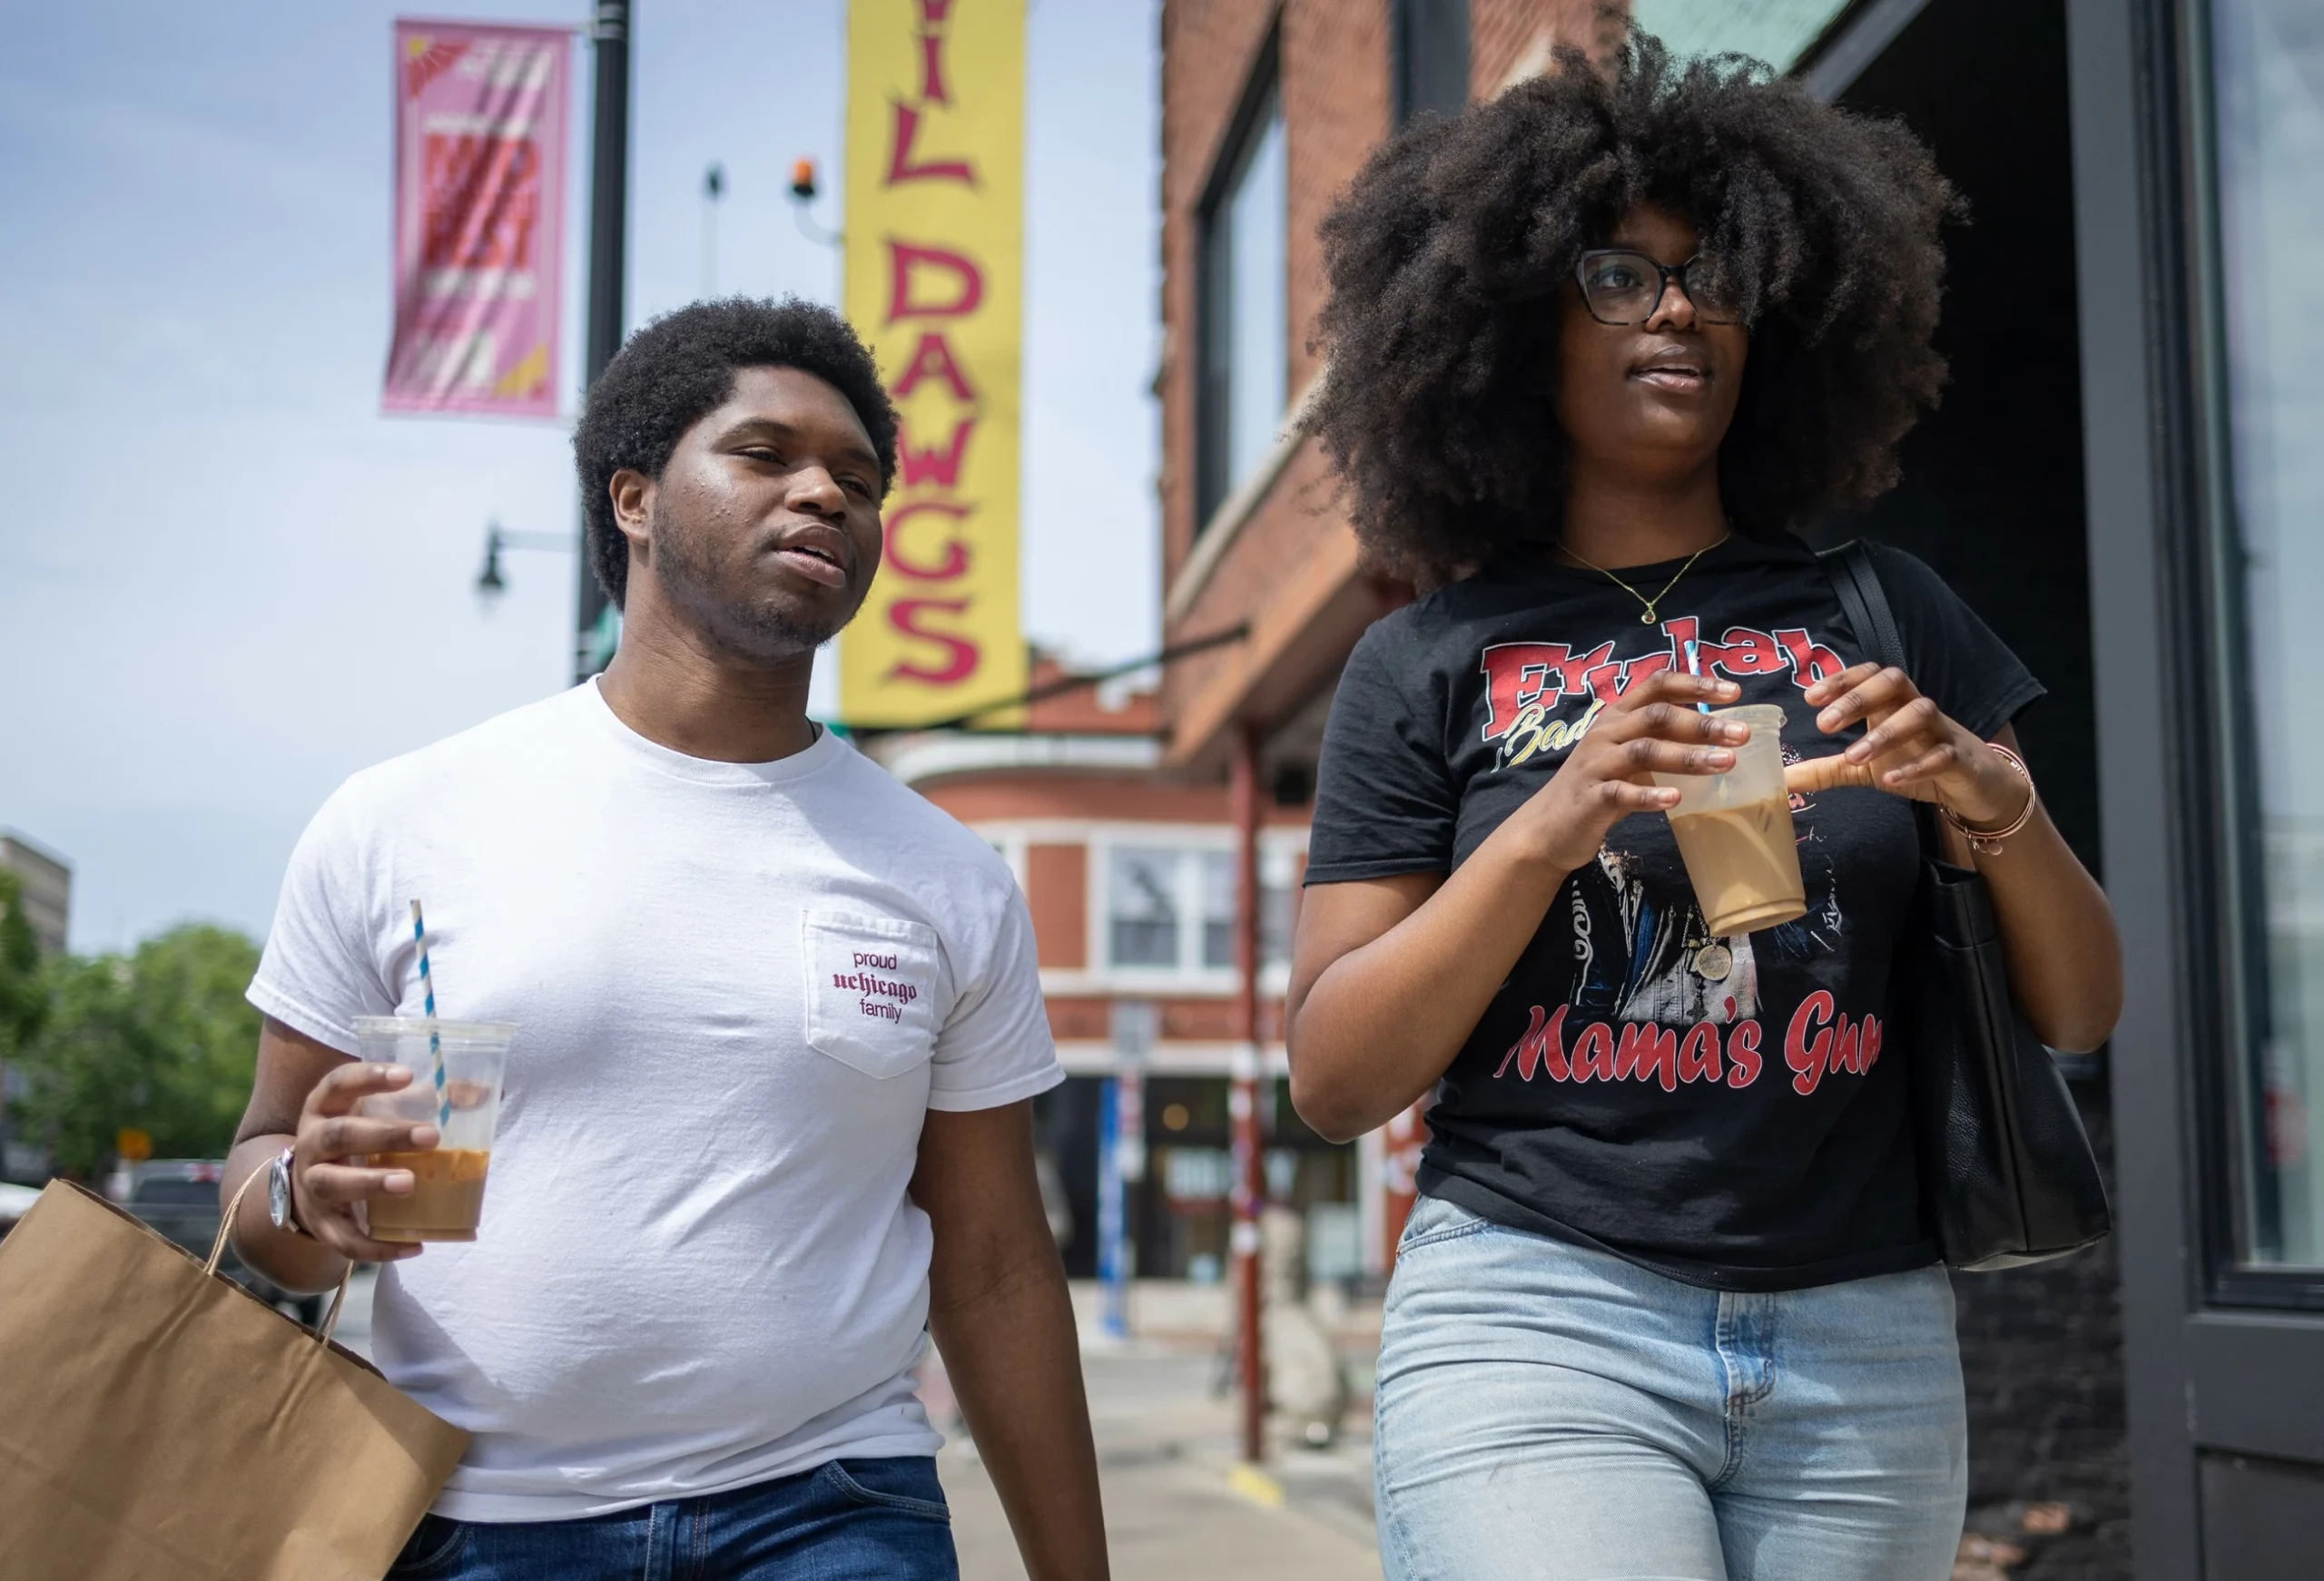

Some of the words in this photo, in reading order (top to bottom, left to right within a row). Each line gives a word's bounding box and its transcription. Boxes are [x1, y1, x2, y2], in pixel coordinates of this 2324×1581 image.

[881, 236, 985, 687] DAWGS
[1491, 697, 1606, 773] Bad
[832, 971, 917, 1005] uchicago
[852, 952, 897, 970] proud
[860, 998, 902, 1025] family
[1492, 995, 1763, 1093] Mama's
[1784, 989, 1884, 1095] Gun
